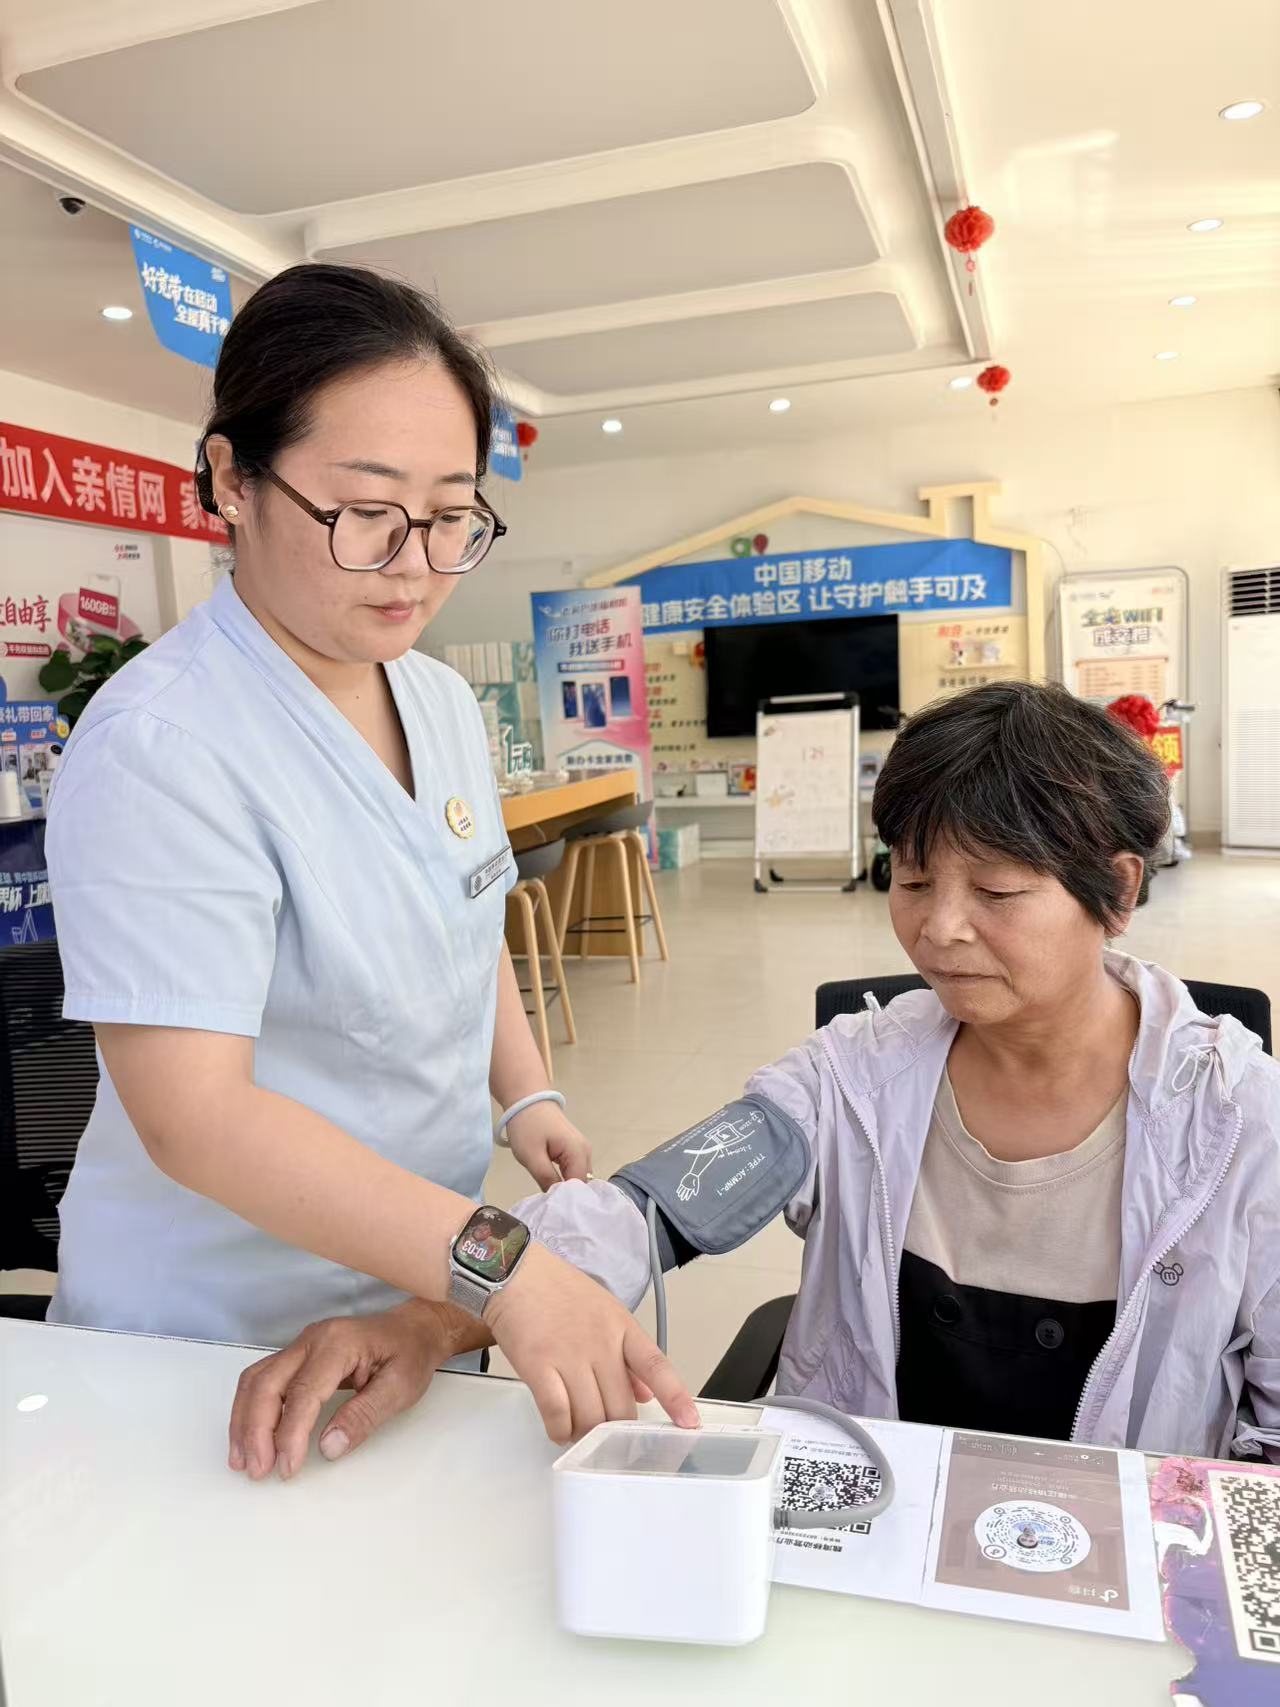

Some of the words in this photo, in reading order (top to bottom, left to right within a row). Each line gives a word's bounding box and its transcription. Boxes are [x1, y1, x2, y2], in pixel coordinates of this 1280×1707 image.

[0, 436, 166, 524] 加入亲情网
[754, 556, 852, 587] 中国移动
[808, 574, 987, 611] 让守护触手可及
[0, 595, 51, 633] 自由享
[569, 633, 632, 657] 我送手机
[463, 1240, 488, 1260] 10:03
